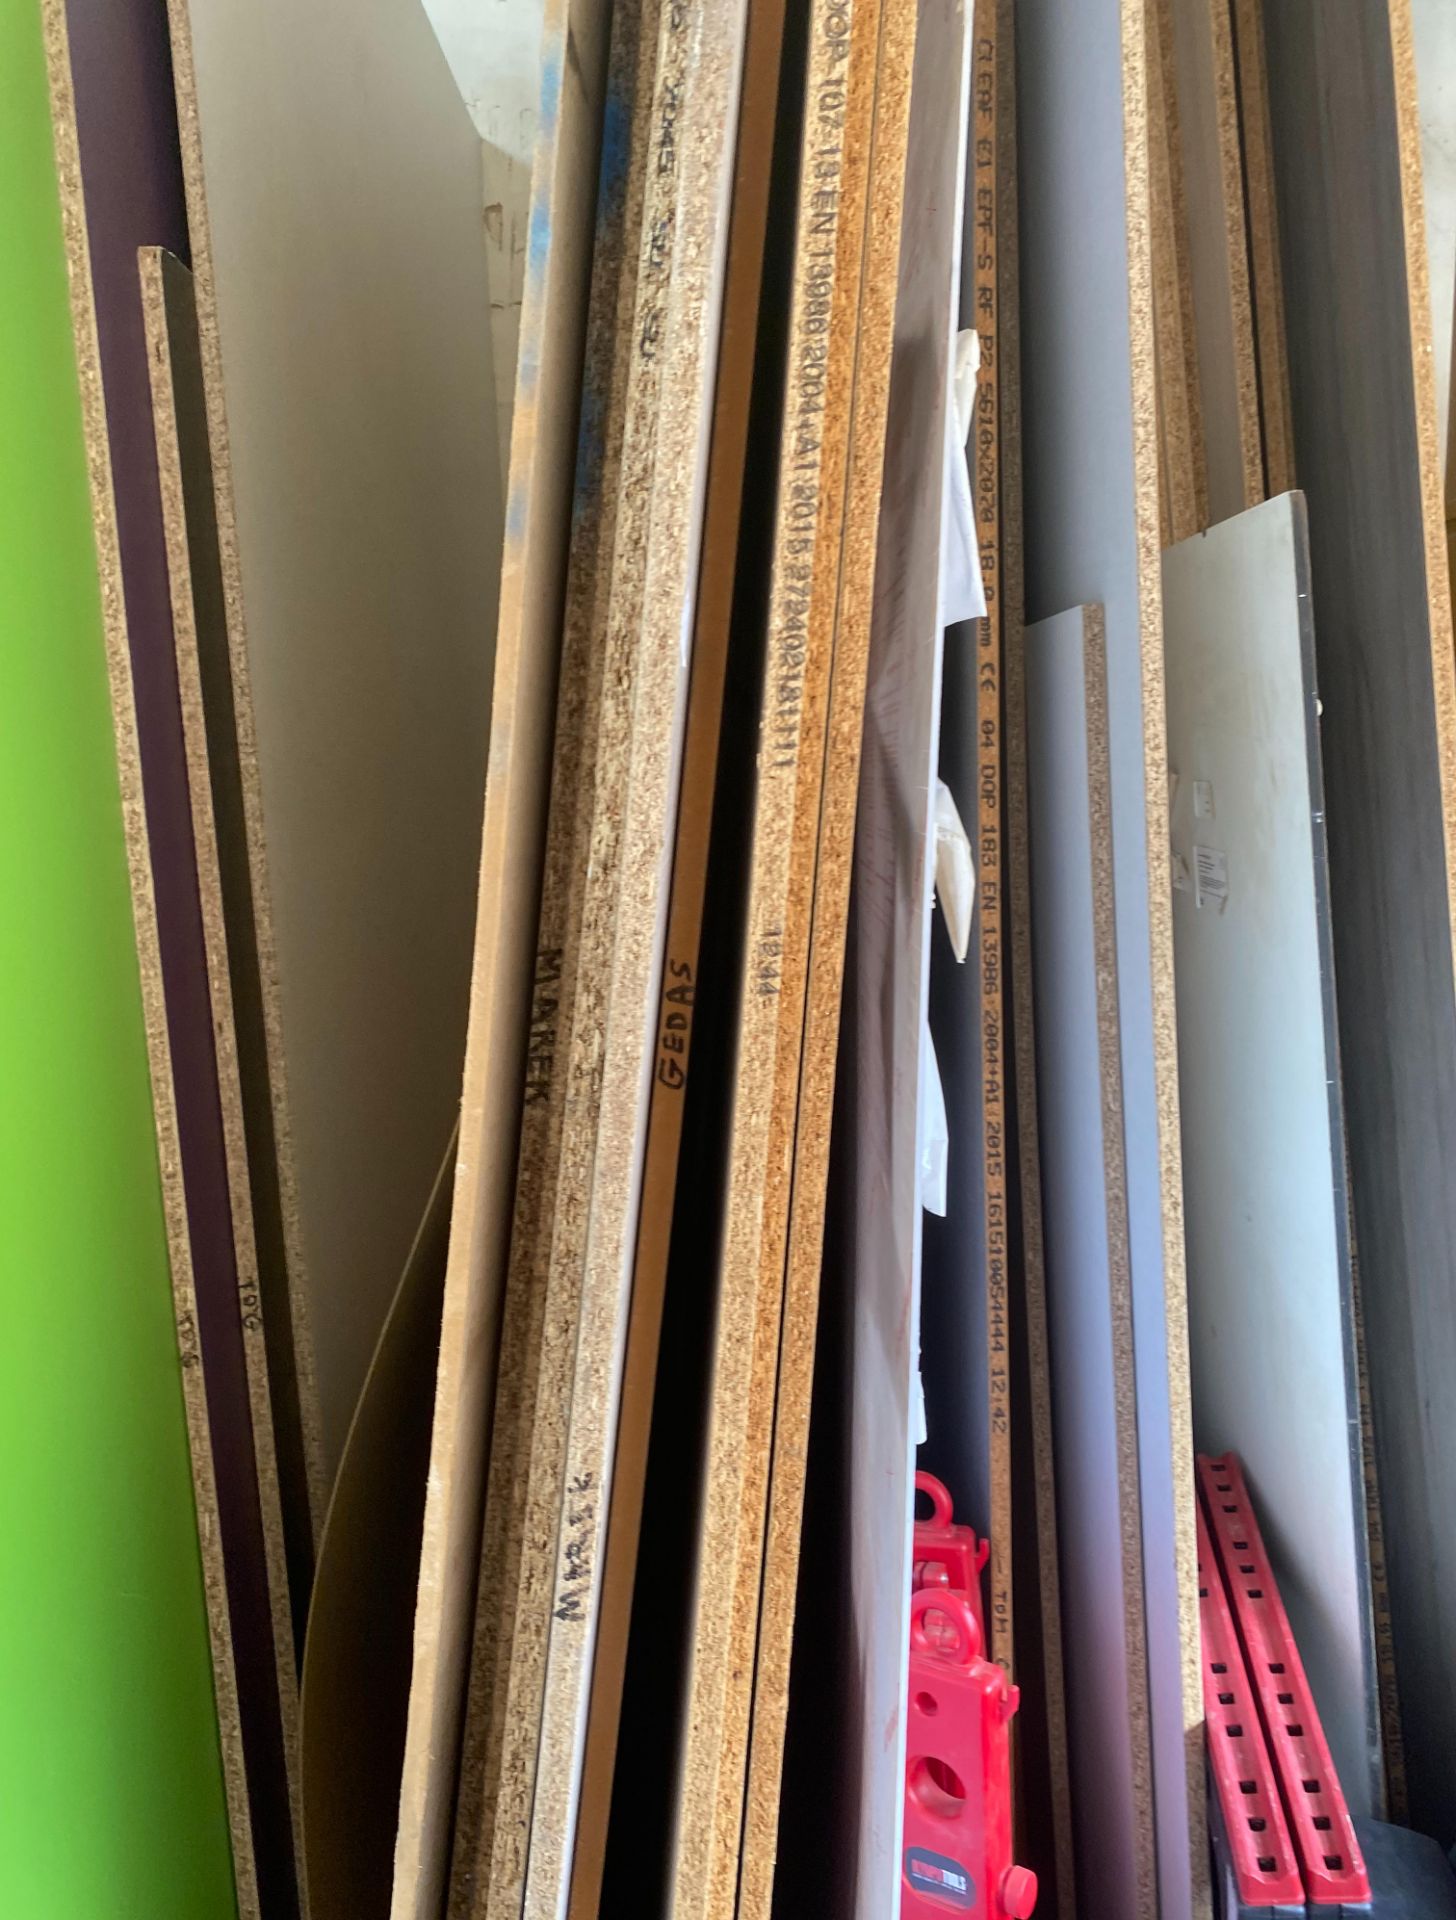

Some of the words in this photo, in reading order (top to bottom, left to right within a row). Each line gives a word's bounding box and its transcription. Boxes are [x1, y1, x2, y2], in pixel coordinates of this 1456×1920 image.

[977, 139, 993, 168] E1
[810, 190, 839, 235] EN
[977, 188, 993, 270] EPF-S
[978, 287, 993, 318] RF
[979, 335, 994, 367] P2
[980, 383, 995, 522] 5610x2070
[981, 617, 993, 647] mm
[981, 720, 996, 748] 04
[981, 765, 997, 809] DOP
[981, 825, 998, 867] 183
[981, 882, 998, 910] EN
[658, 959, 695, 1090] GEDAS
